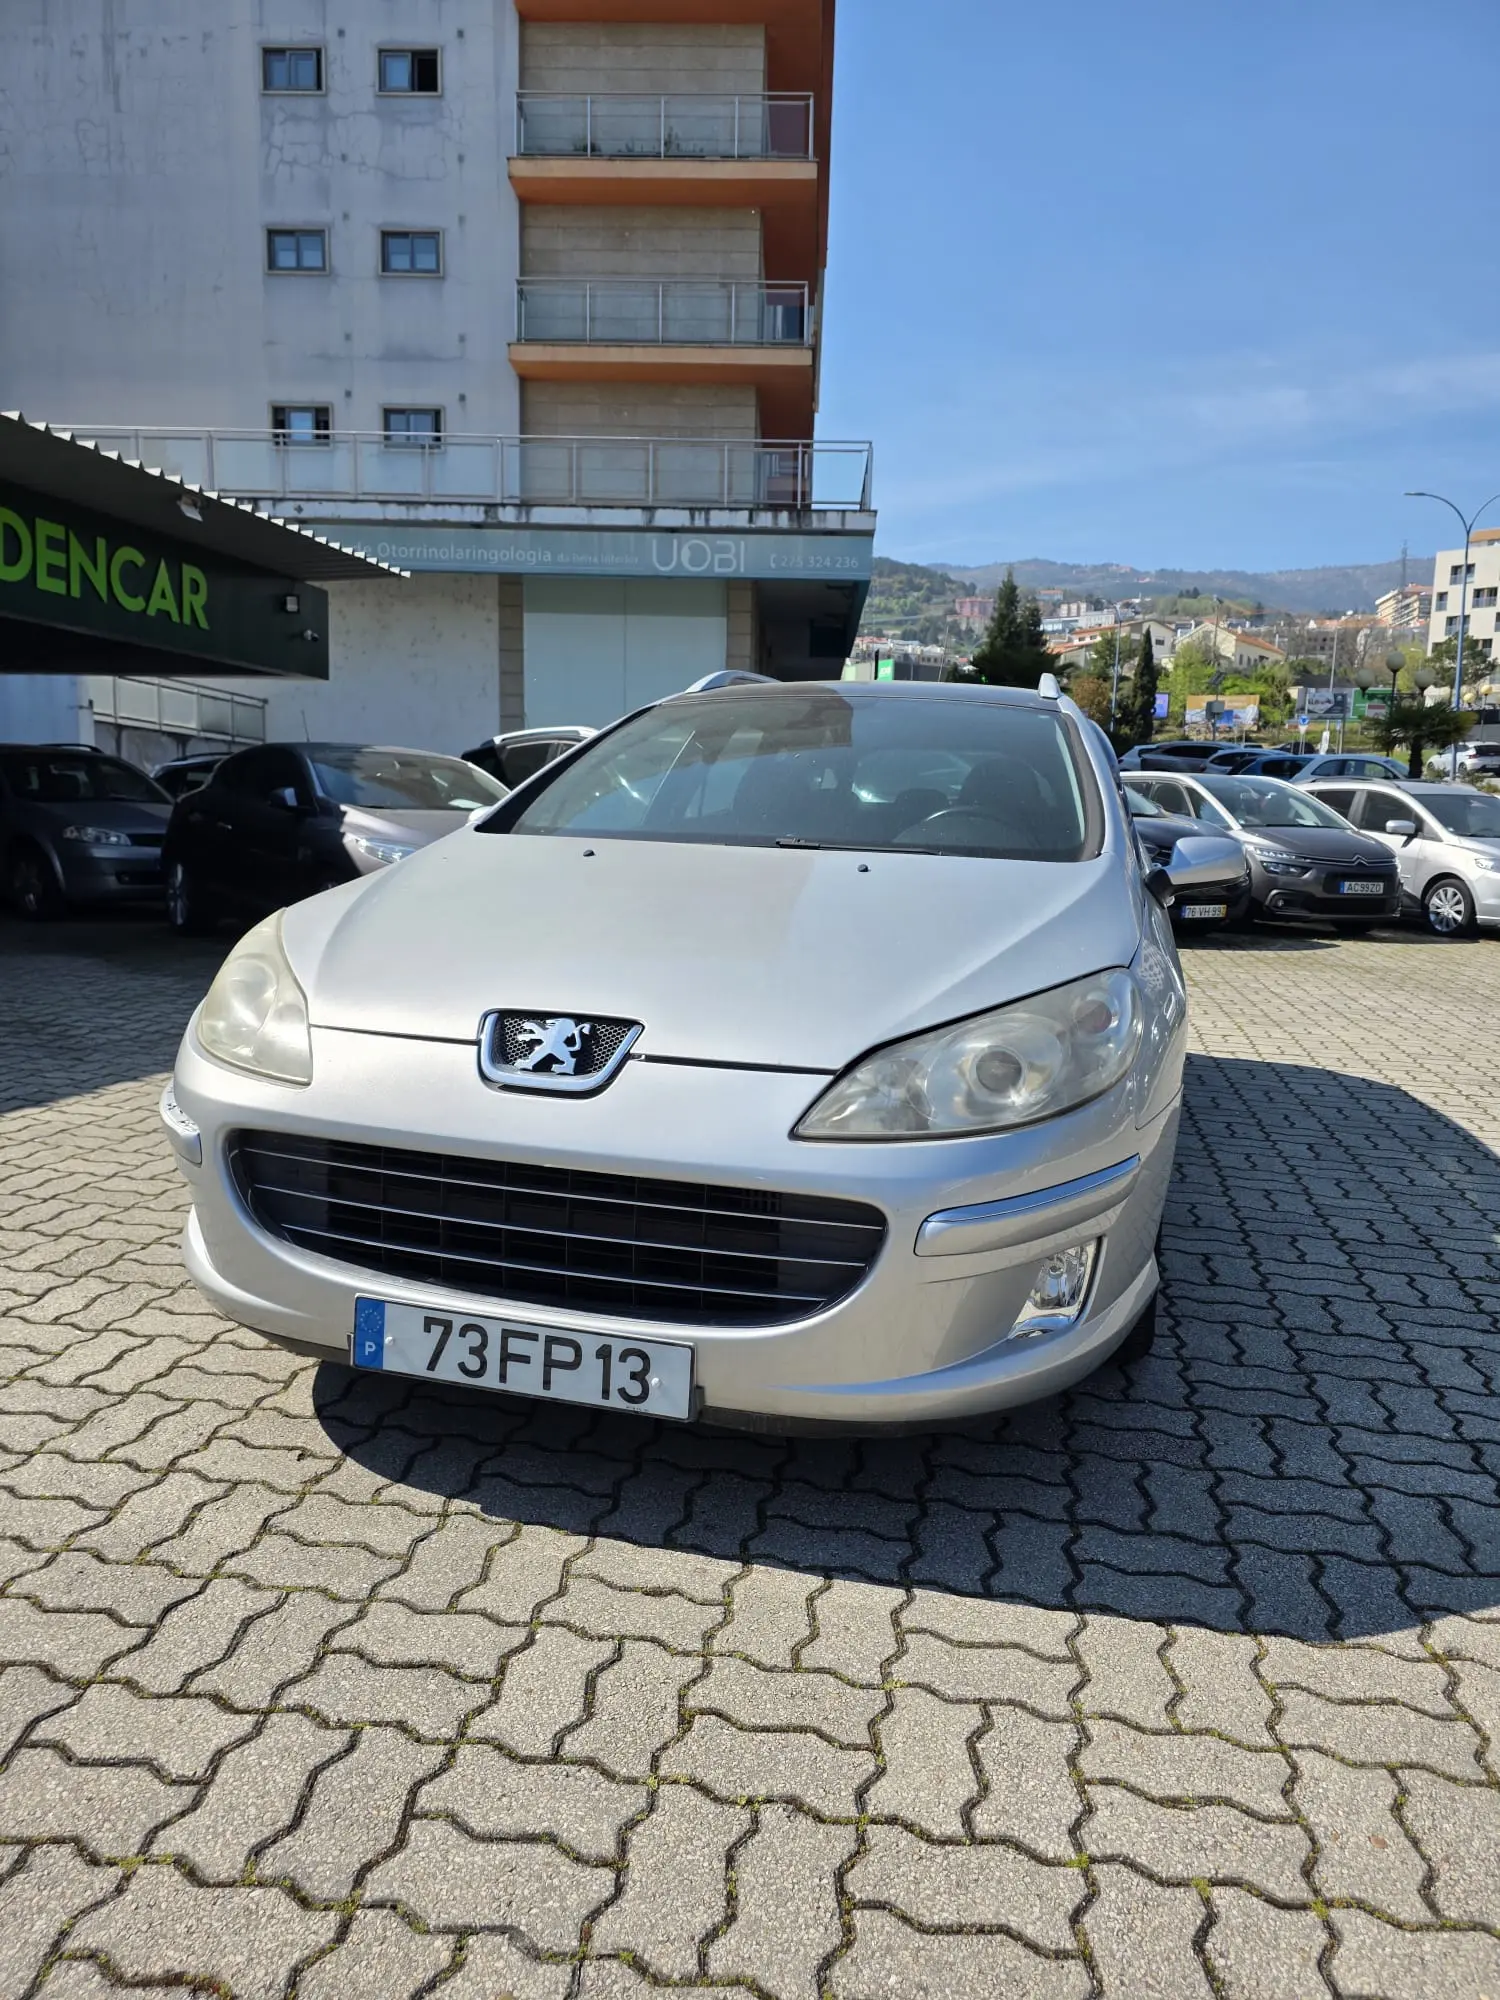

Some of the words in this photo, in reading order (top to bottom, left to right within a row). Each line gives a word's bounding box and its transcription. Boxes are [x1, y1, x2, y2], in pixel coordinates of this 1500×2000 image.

[377, 542, 552, 565] Otorrinolaringologia
[652, 537, 746, 573] UOBI
[808, 555, 831, 569] 324
[835, 556, 859, 569] 236
[0, 506, 210, 630] DENCAR
[364, 1340, 377, 1356] P
